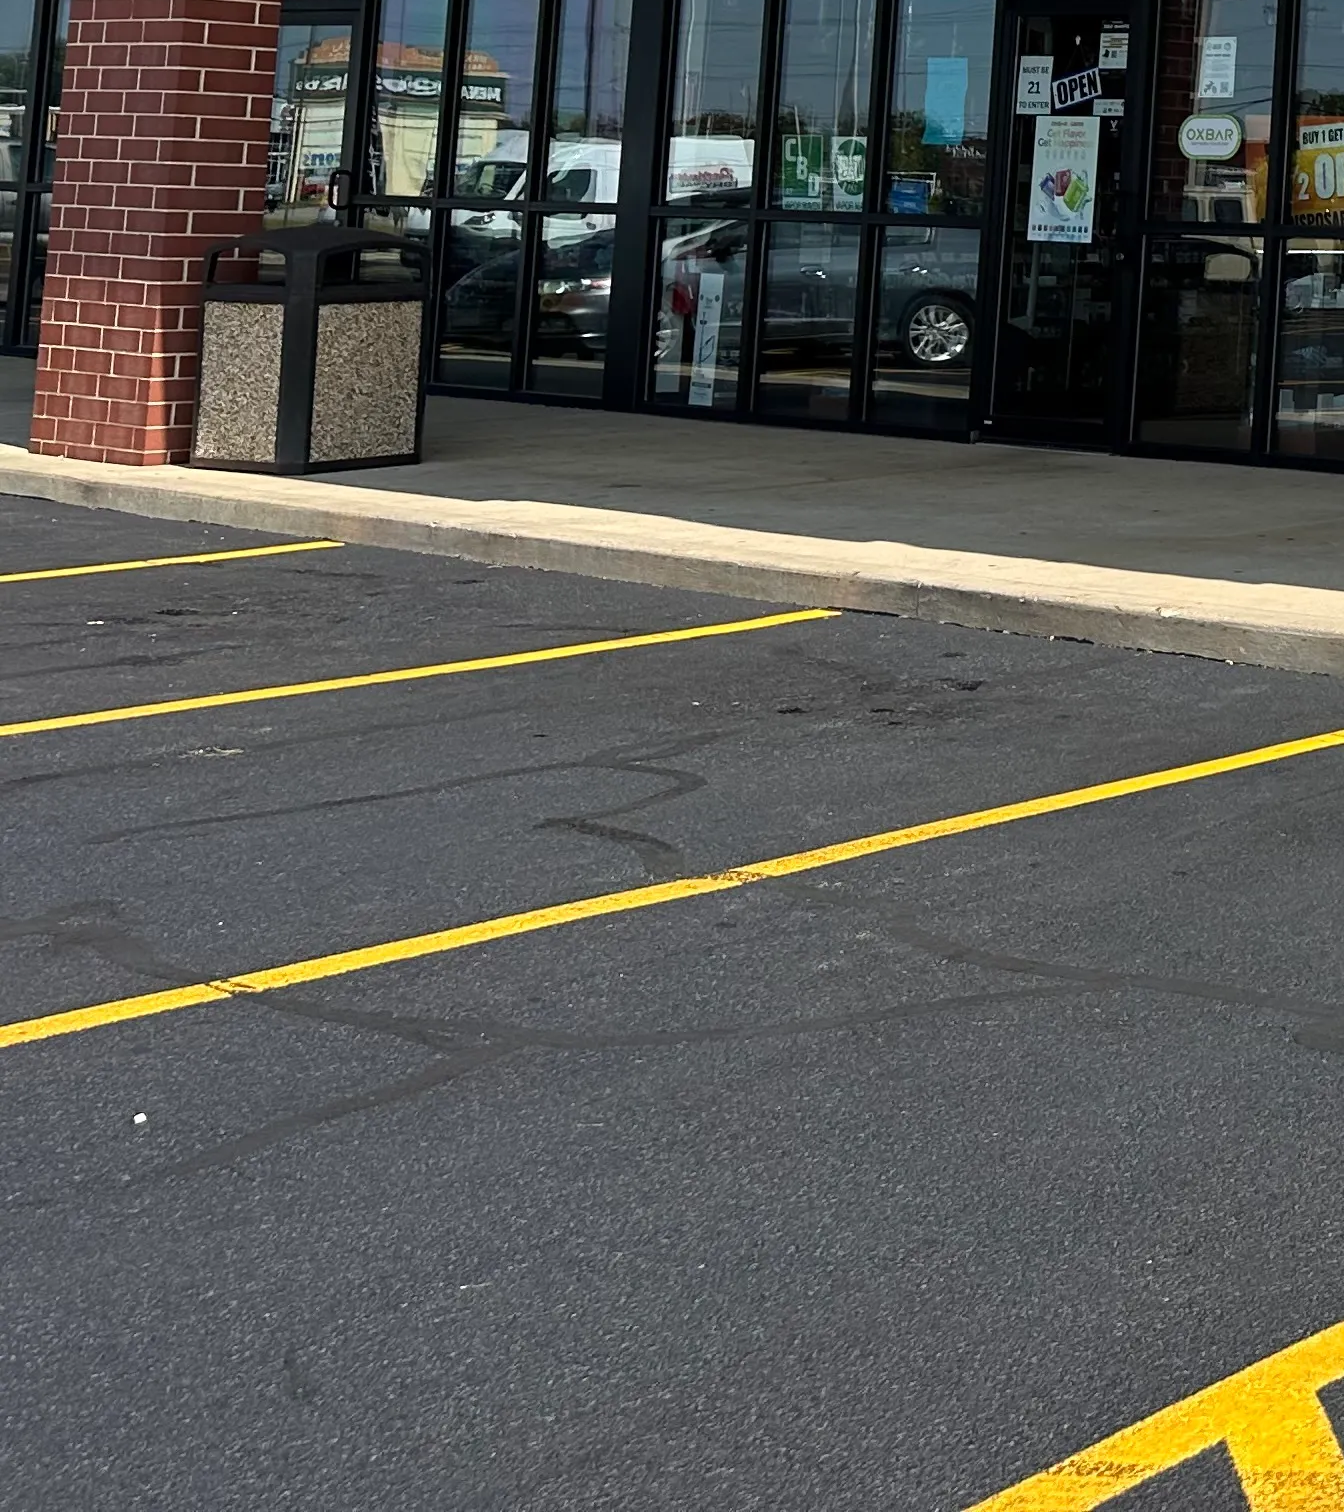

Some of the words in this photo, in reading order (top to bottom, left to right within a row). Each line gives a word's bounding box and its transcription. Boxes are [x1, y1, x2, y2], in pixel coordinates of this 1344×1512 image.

[1022, 66, 1040, 74] MUST
[1041, 66, 1049, 74] BE
[1027, 81, 1041, 94] 21
[1056, 70, 1099, 106] OPEN
[1019, 101, 1026, 109] TO
[1028, 101, 1049, 109] ENTER
[1186, 128, 1234, 141] OXBAR
[1302, 131, 1320, 145] BUY
[1322, 130, 1326, 143] 1
[1328, 129, 1344, 142] GET
